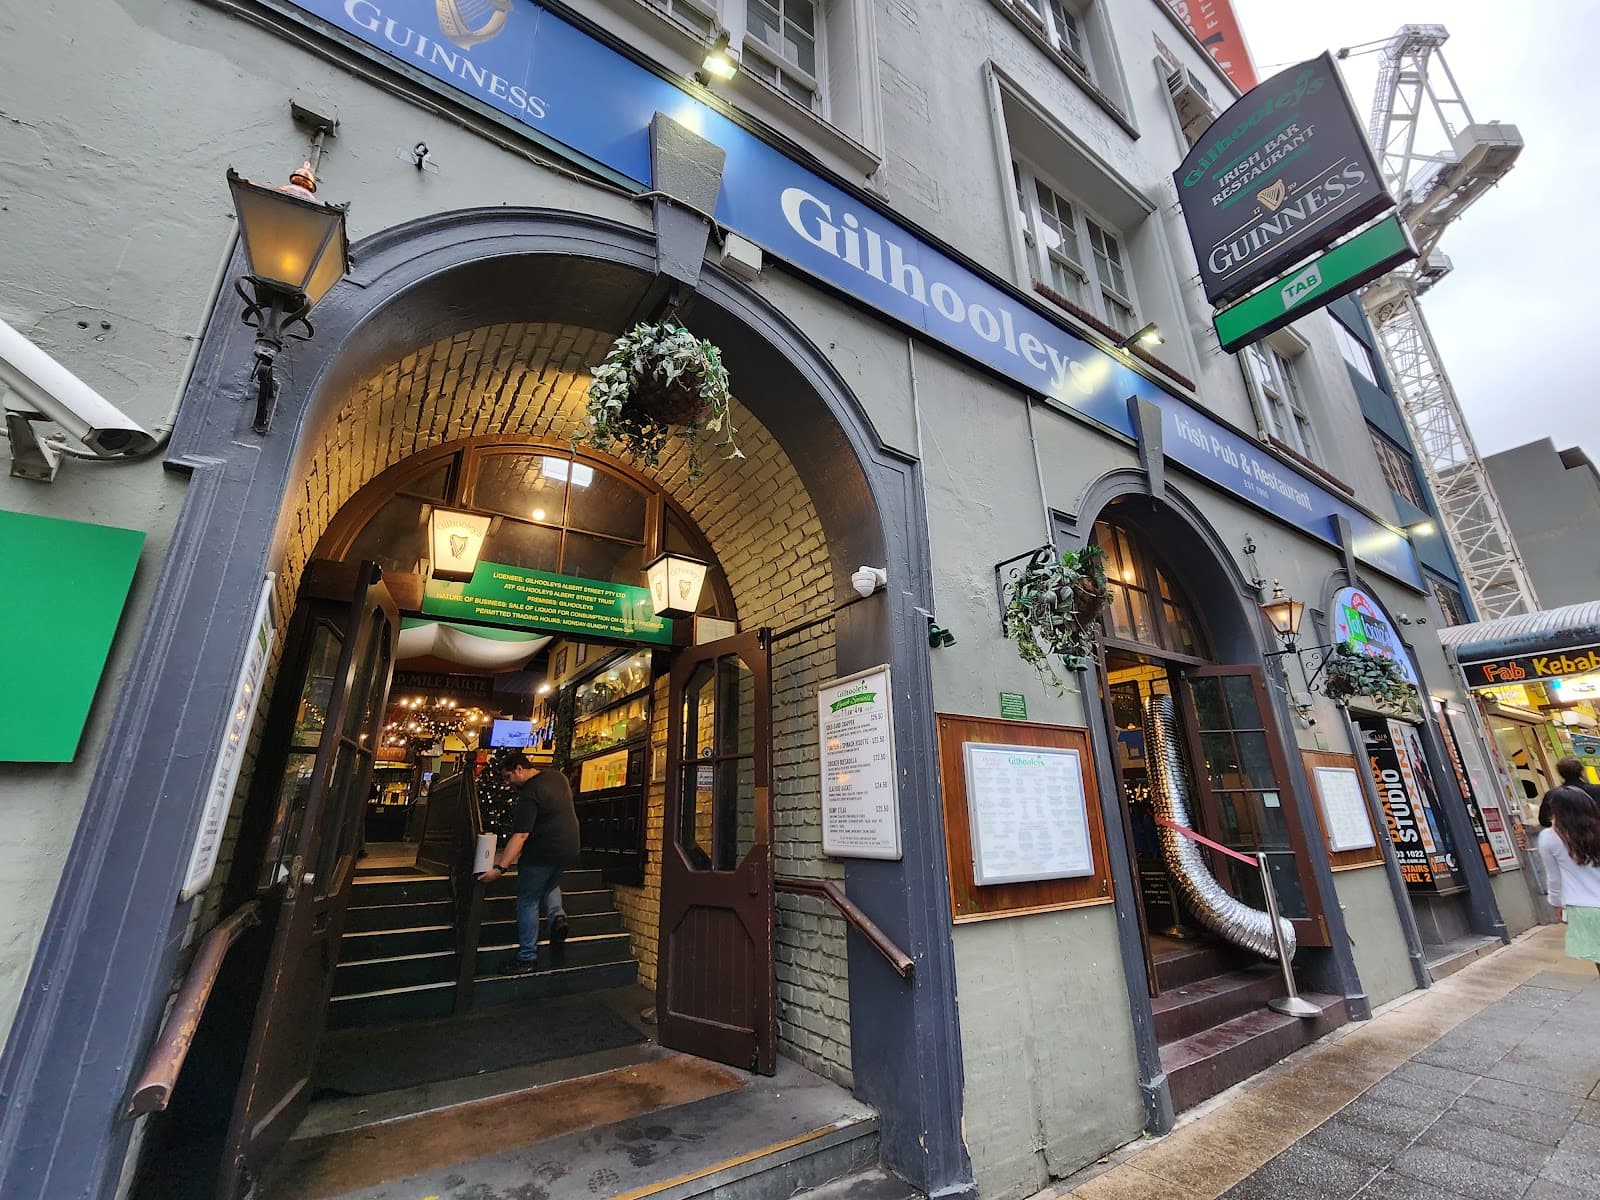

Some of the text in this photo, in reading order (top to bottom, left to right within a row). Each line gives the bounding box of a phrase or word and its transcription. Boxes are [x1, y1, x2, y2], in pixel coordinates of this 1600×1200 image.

[344, 0, 547, 119] GUINNESS
[1211, 124, 1316, 207] RESTAURANT
[1218, 123, 1300, 188] IRISH BAR
[1208, 161, 1365, 274] GUINNESS
[780, 186, 1094, 394] Gilhooleys
[1284, 274, 1318, 298] TAB
[1174, 413, 1313, 511] Irish Pub & Restaurant
[516, 585, 554, 596] GILHOOLEYS
[554, 591, 575, 599] ALBERT
[576, 594, 597, 603] STREET
[598, 597, 615, 605] TRUST
[525, 577, 562, 589] GILHOOLEYS
[562, 583, 583, 592] ALBERT
[583, 586, 605, 595] STREET
[605, 589, 616, 598] PTY
[616, 591, 626, 599] LTD
[436, 592, 463, 602] NATURE
[464, 595, 474, 603] OF
[508, 602, 524, 610] SALE
[534, 606, 557, 615] LIQUOR
[557, 609, 570, 617] FOR
[570, 611, 610, 622] CONSUMPTION
[475, 607, 511, 618] PERMITTED
[512, 612, 539, 621] TRADING
[559, 600, 594, 611] GILHOOLEYS
[1483, 651, 1600, 682] Fab Kebab
[1391, 727, 1433, 847] BOXING
[1381, 769, 1419, 843] STUDIO
[1406, 850, 1425, 858] 1022
[1424, 872, 1433, 882] 2
